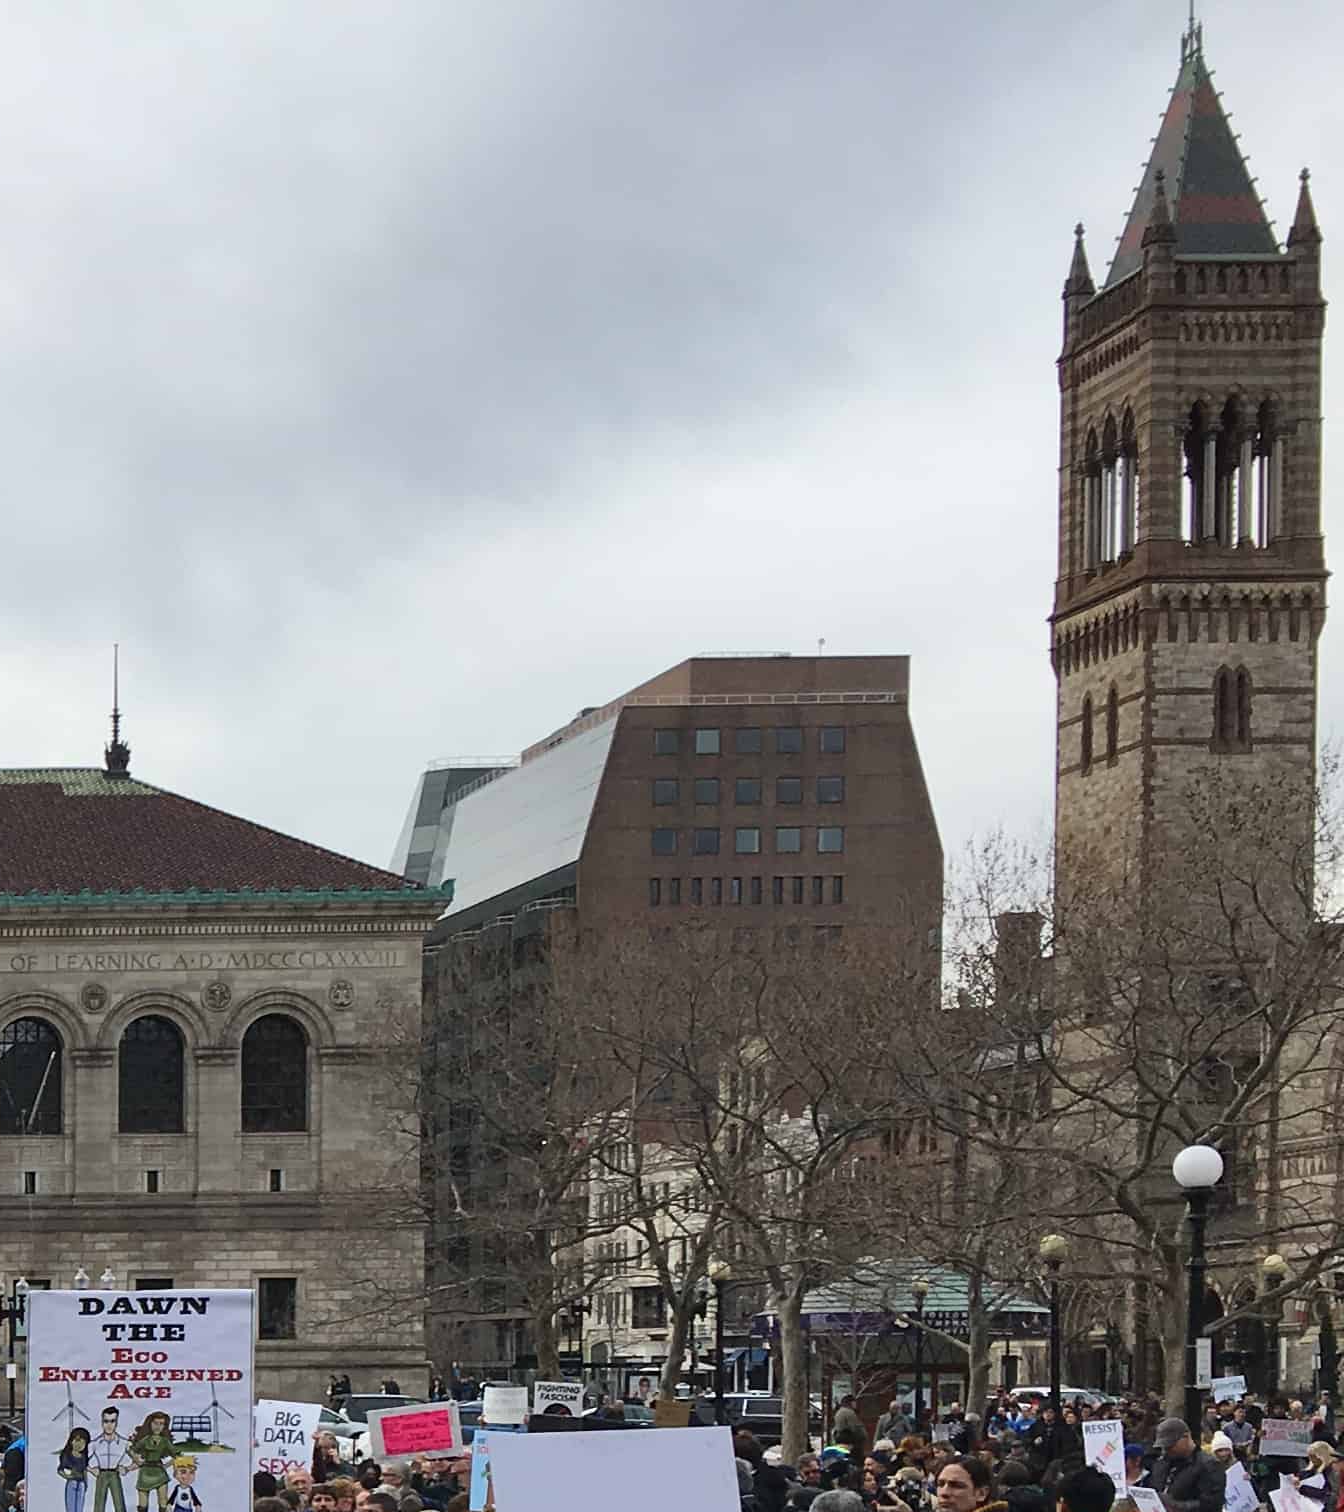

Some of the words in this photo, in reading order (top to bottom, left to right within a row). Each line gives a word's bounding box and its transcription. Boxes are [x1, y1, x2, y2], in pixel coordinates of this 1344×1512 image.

[9, 954, 39, 972] OF
[55, 954, 161, 971] LEARNING
[78, 1297, 211, 1315] DAWN
[102, 1324, 185, 1342] THE
[537, 1384, 581, 1394] FIGHTING
[539, 1392, 578, 1402] FASCISM
[275, 1411, 302, 1428] BIG
[263, 1427, 306, 1447] DATA
[1085, 1423, 1119, 1436] RESIST
